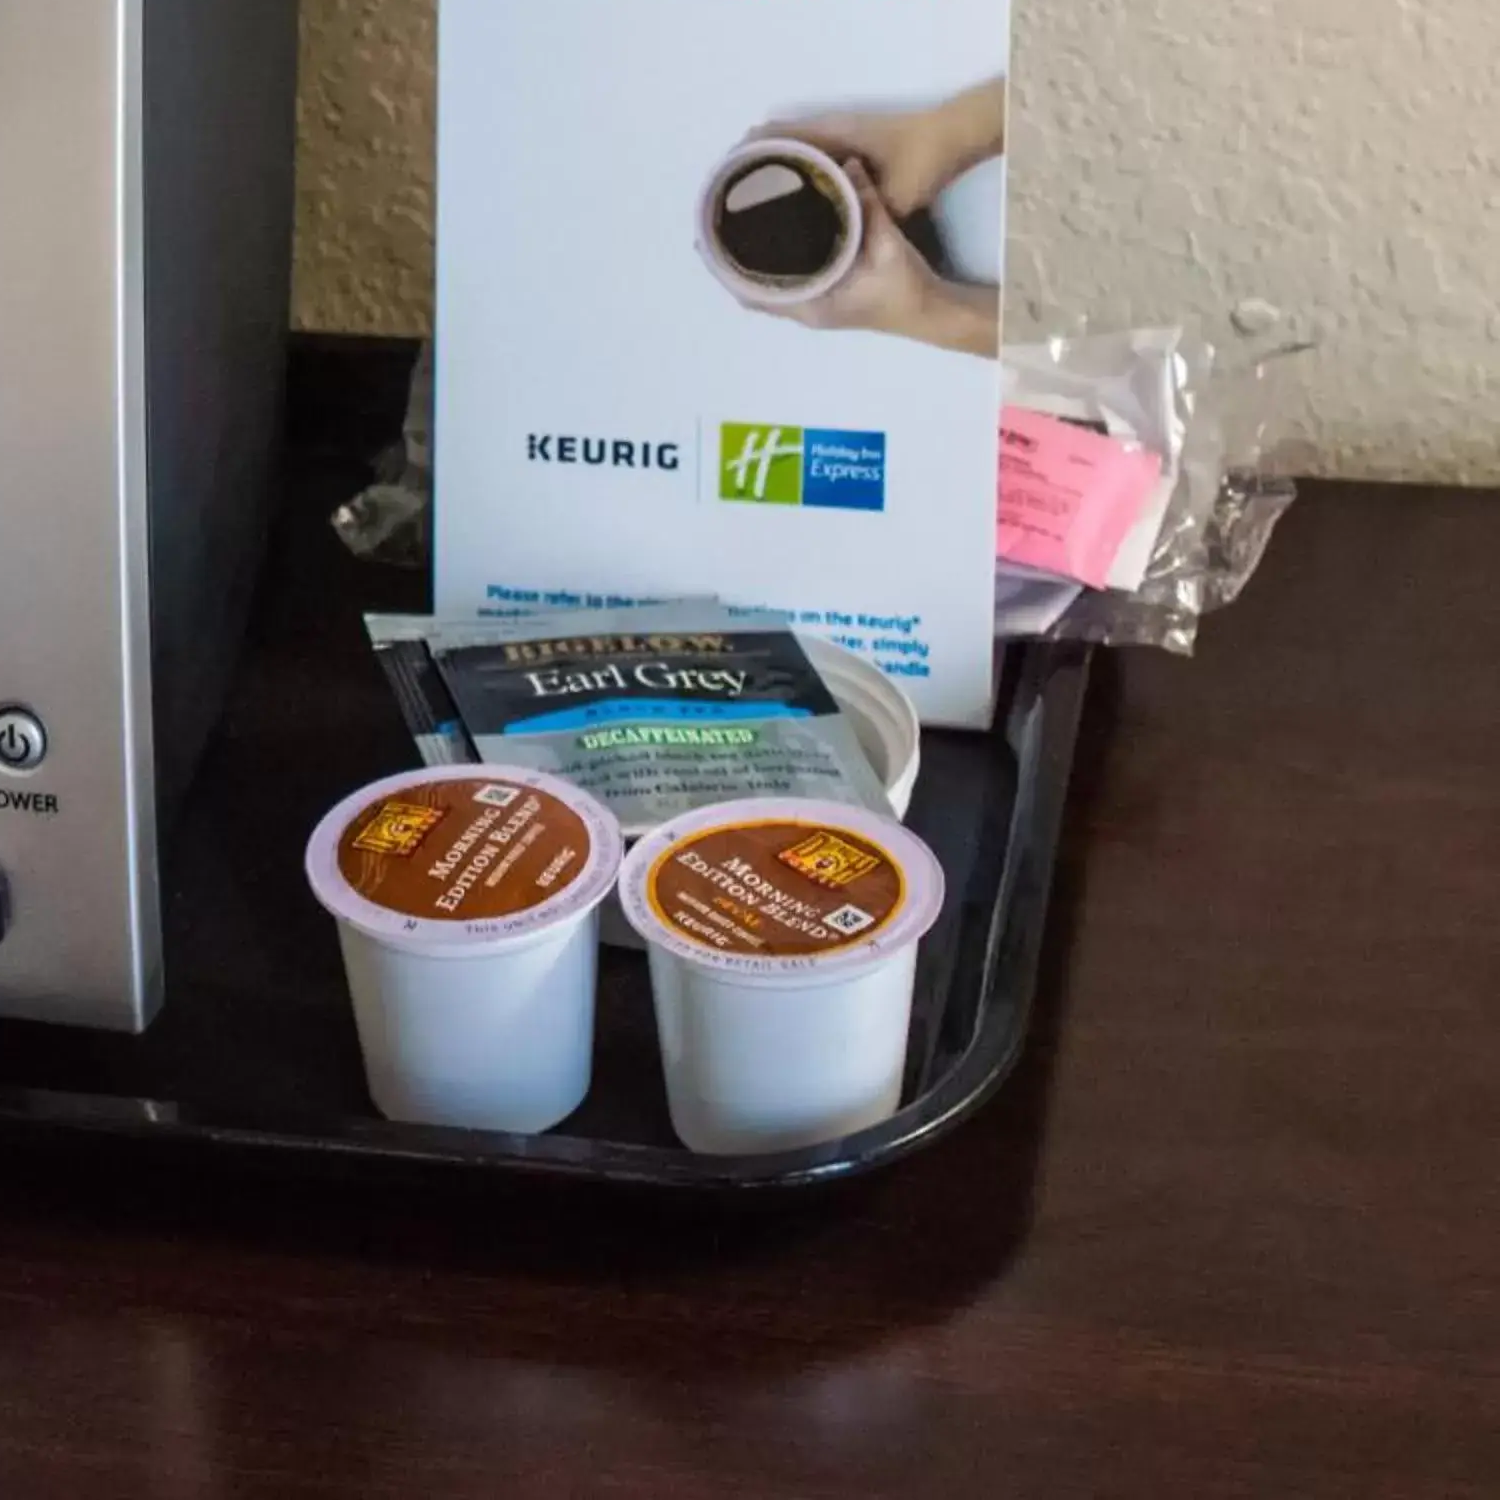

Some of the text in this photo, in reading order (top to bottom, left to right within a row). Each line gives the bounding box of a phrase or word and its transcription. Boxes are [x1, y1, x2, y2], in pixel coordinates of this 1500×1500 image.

[527, 433, 680, 470] KEURIG
[810, 459, 882, 483] Express
[487, 584, 540, 601] Please
[801, 610, 821, 623] on
[825, 610, 853, 625] the
[872, 638, 930, 658] simply
[525, 661, 746, 696] Earl Grey
[583, 726, 754, 749] DECAFFEINATED
[428, 807, 501, 881] MORNING
[435, 842, 500, 912] EDITION
[675, 850, 761, 906] EDITION
[721, 856, 821, 919] MORNING
